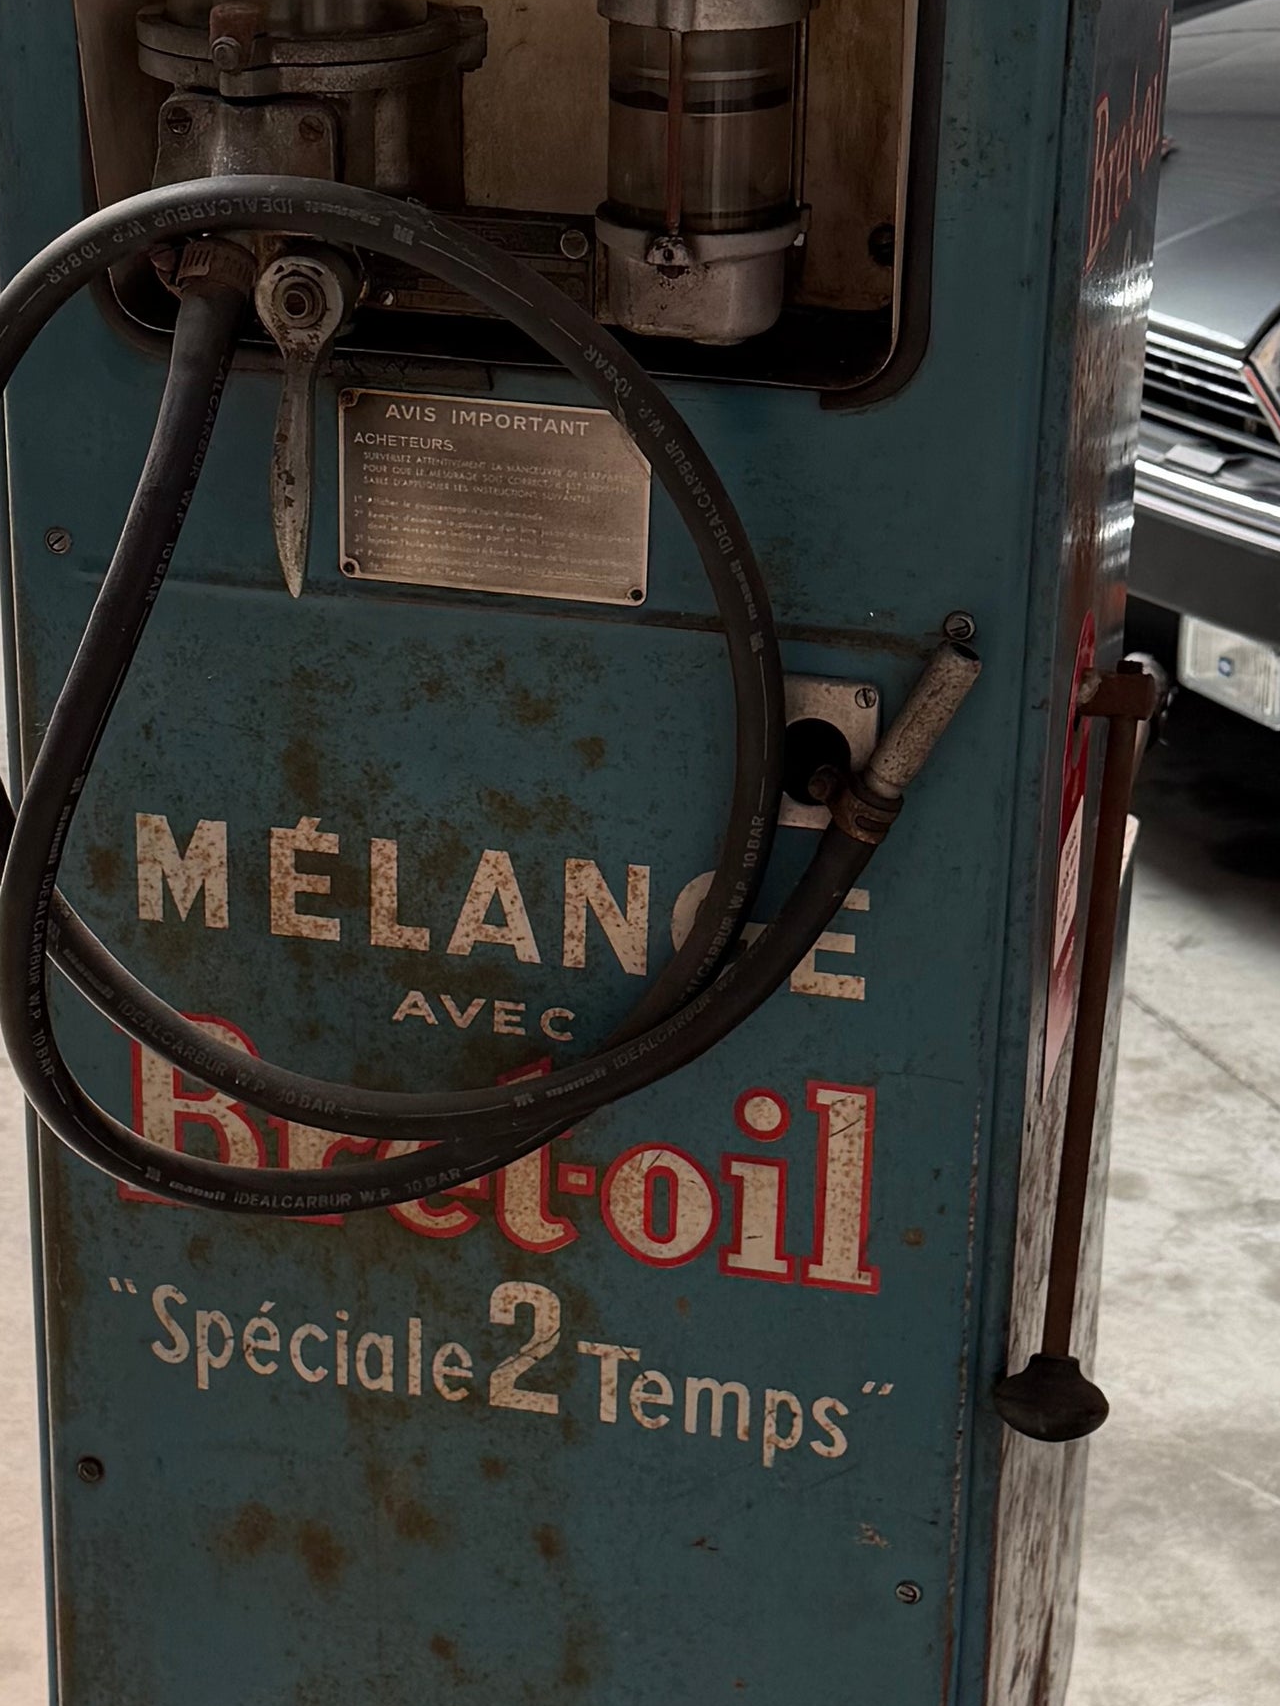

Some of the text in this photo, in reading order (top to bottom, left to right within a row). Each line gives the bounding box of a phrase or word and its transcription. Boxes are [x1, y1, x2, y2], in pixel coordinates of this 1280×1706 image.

[153, 196, 294, 229] IDEALCARBUR
[353, 431, 457, 453] ACHETEURS.
[385, 403, 591, 437] AVIS IMPORTANT
[665, 440, 734, 555] IDEALCARBUR
[28, 871, 55, 988] IDEALCARBUR
[117, 997, 228, 1078] IDEALCARBUR
[391, 988, 579, 1043] AVEC
[233, 1191, 352, 1209] IDEALCARBUR
[488, 1280, 562, 1416] 2
